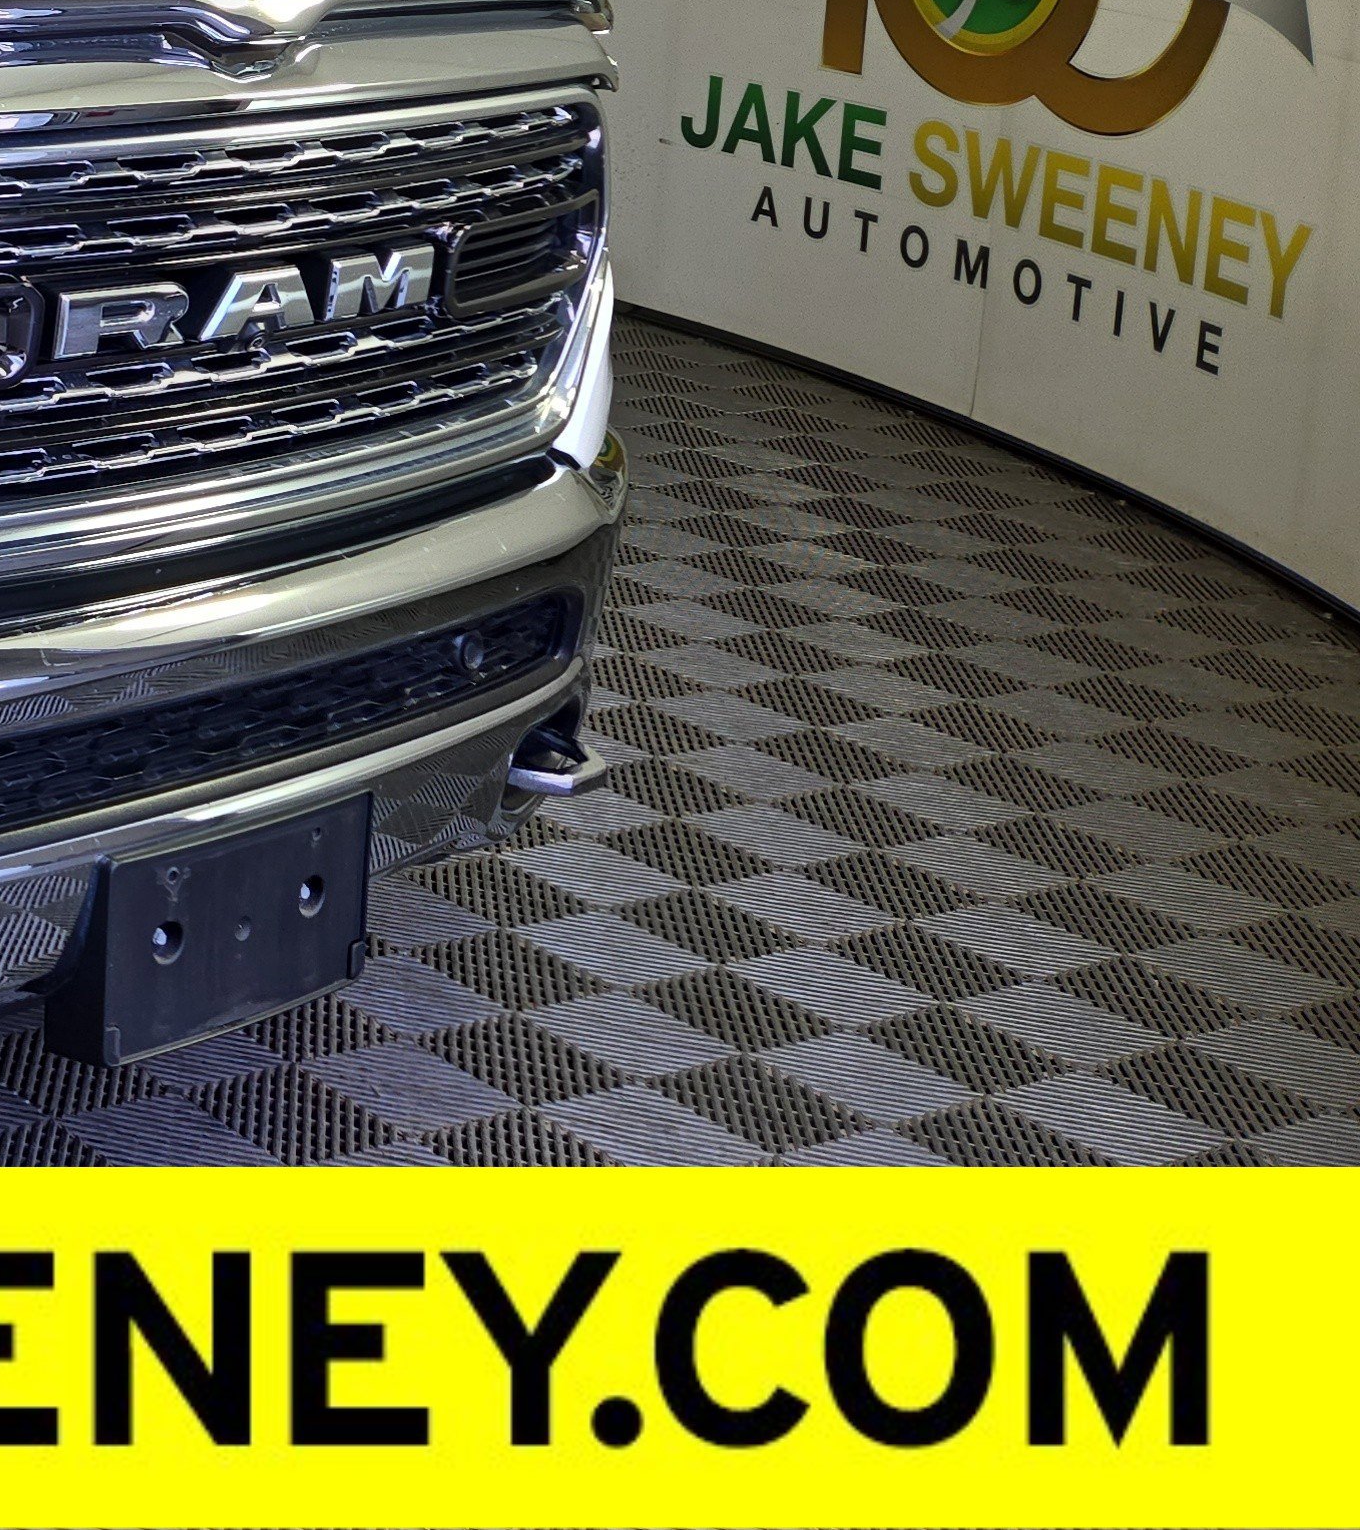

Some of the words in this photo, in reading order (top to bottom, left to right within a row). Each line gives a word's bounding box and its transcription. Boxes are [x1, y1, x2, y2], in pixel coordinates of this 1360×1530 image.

[681, 75, 887, 191] JAKE
[908, 120, 1313, 321] SWEENEY
[750, 185, 1223, 376] AUTOMOTIVE
[53, 243, 435, 361] RAM
